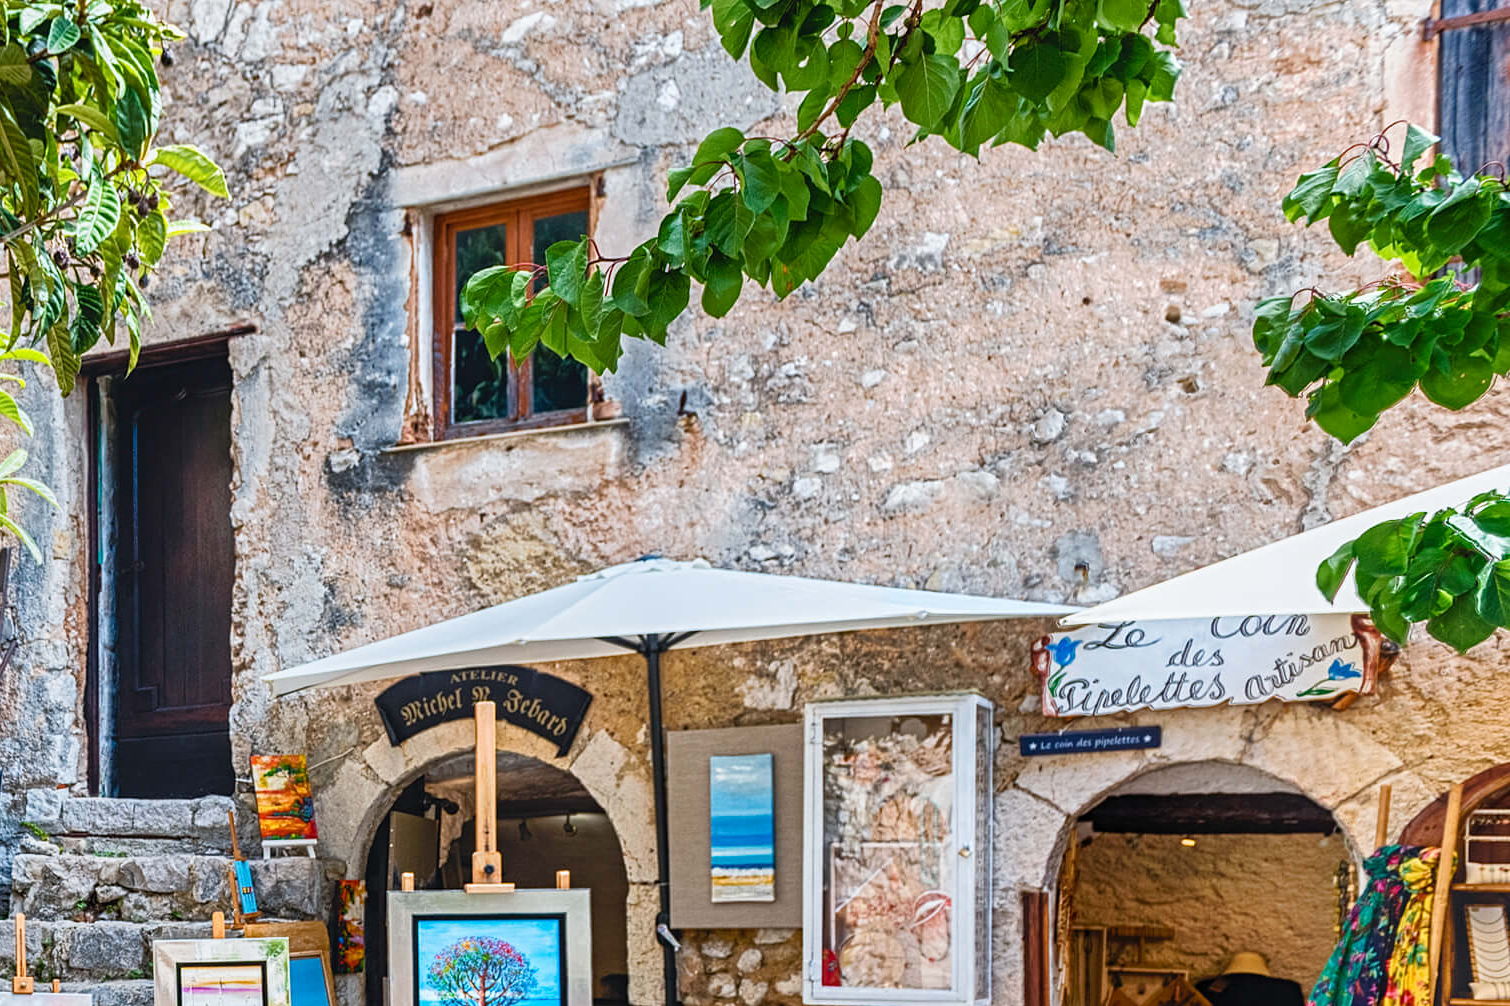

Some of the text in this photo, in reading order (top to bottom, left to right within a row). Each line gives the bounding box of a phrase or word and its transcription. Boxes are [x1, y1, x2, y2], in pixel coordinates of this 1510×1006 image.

[1165, 637, 1225, 668] des
[450, 669, 519, 687] ATELIER
[1057, 670, 1226, 717] Pipelettes
[400, 687, 464, 727] Michel
[1040, 734, 1141, 750] Le coin des pipelettes
